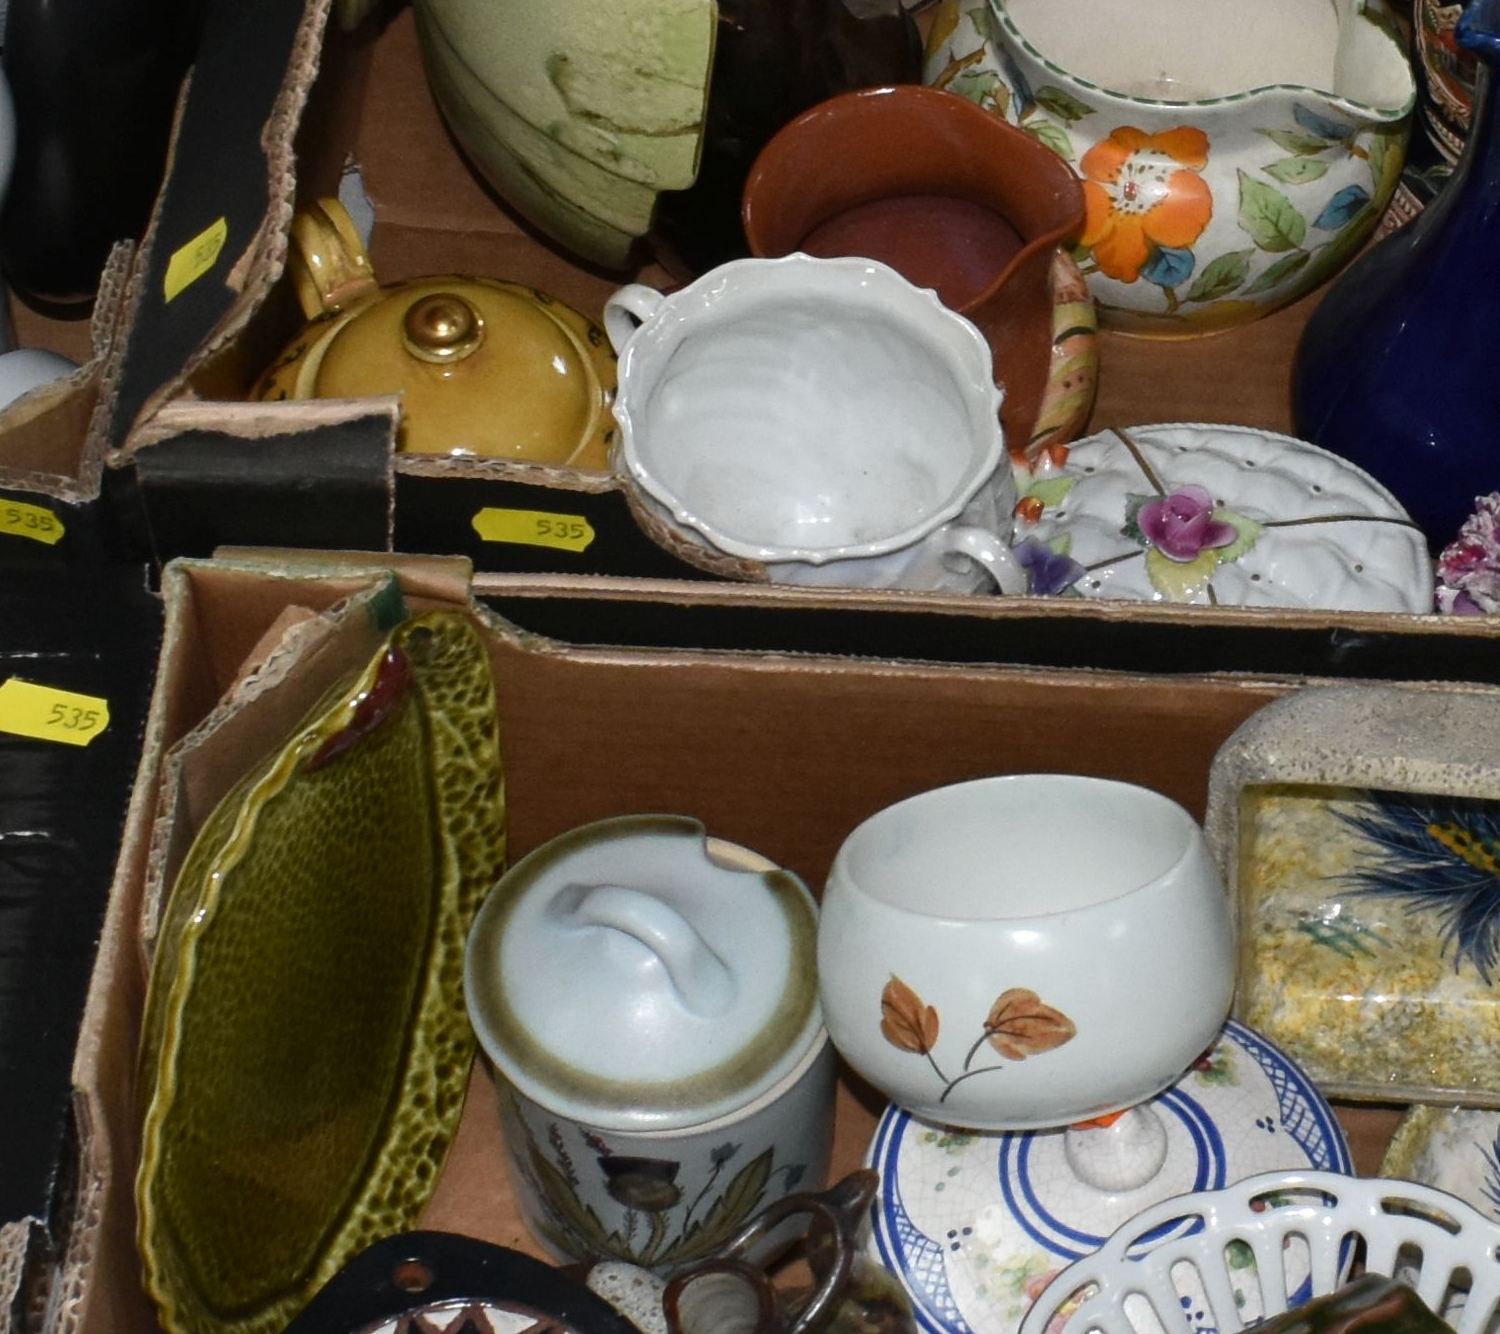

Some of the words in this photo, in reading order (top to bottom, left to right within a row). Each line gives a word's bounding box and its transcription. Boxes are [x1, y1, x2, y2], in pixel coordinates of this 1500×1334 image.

[5, 508, 54, 532] 535
[536, 519, 585, 539] 535
[46, 703, 101, 731] 535
